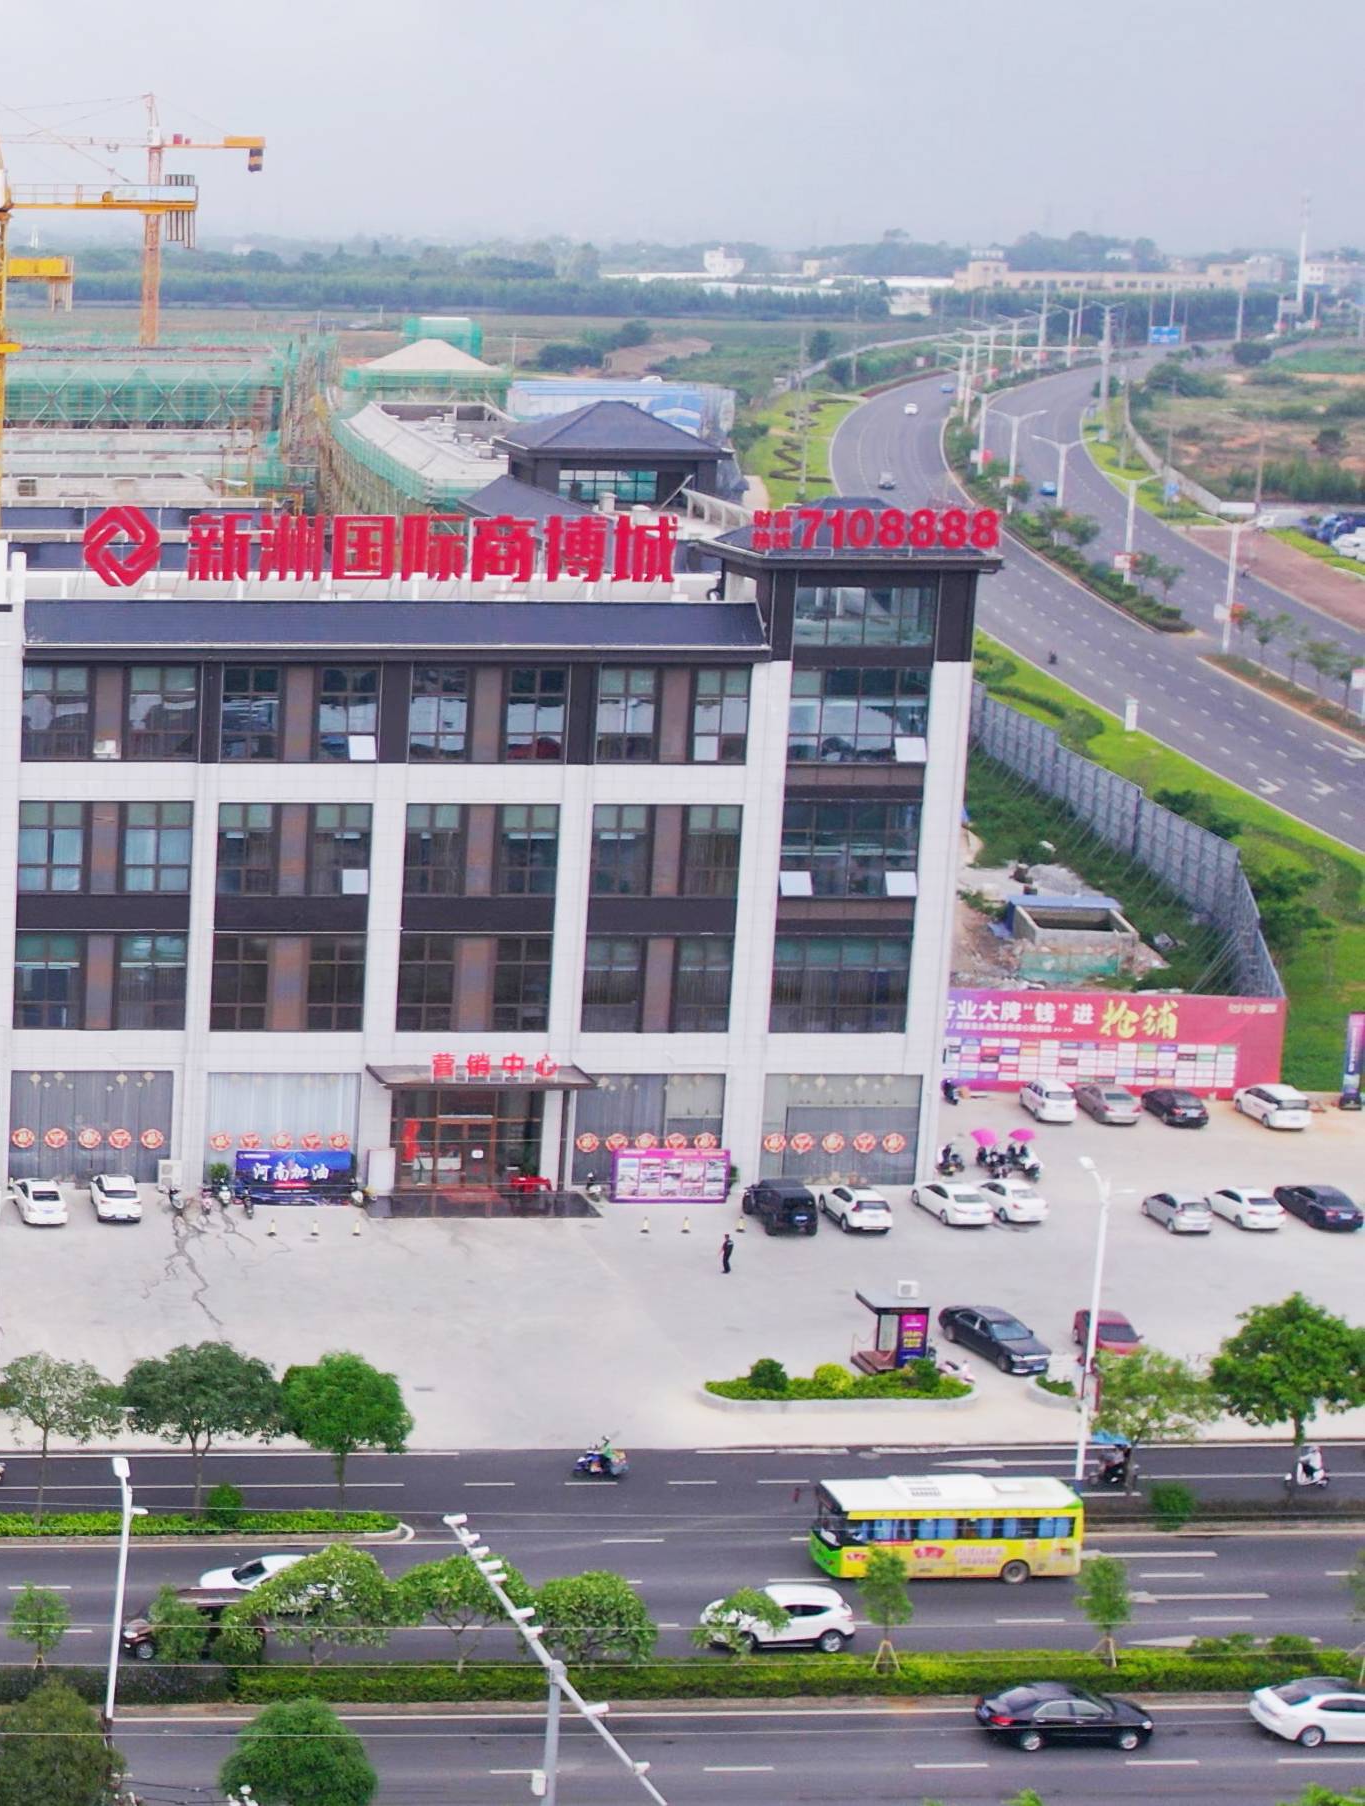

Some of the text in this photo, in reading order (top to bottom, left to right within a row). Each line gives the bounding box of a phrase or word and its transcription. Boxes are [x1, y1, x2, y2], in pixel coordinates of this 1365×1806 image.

[187, 513, 678, 583] 新洲国际商博城
[797, 508, 1000, 550] 7108888
[1099, 999, 1179, 1040] 抢铺
[432, 1052, 561, 1078] 营销中心
[253, 1161, 330, 1182] 河南加油
